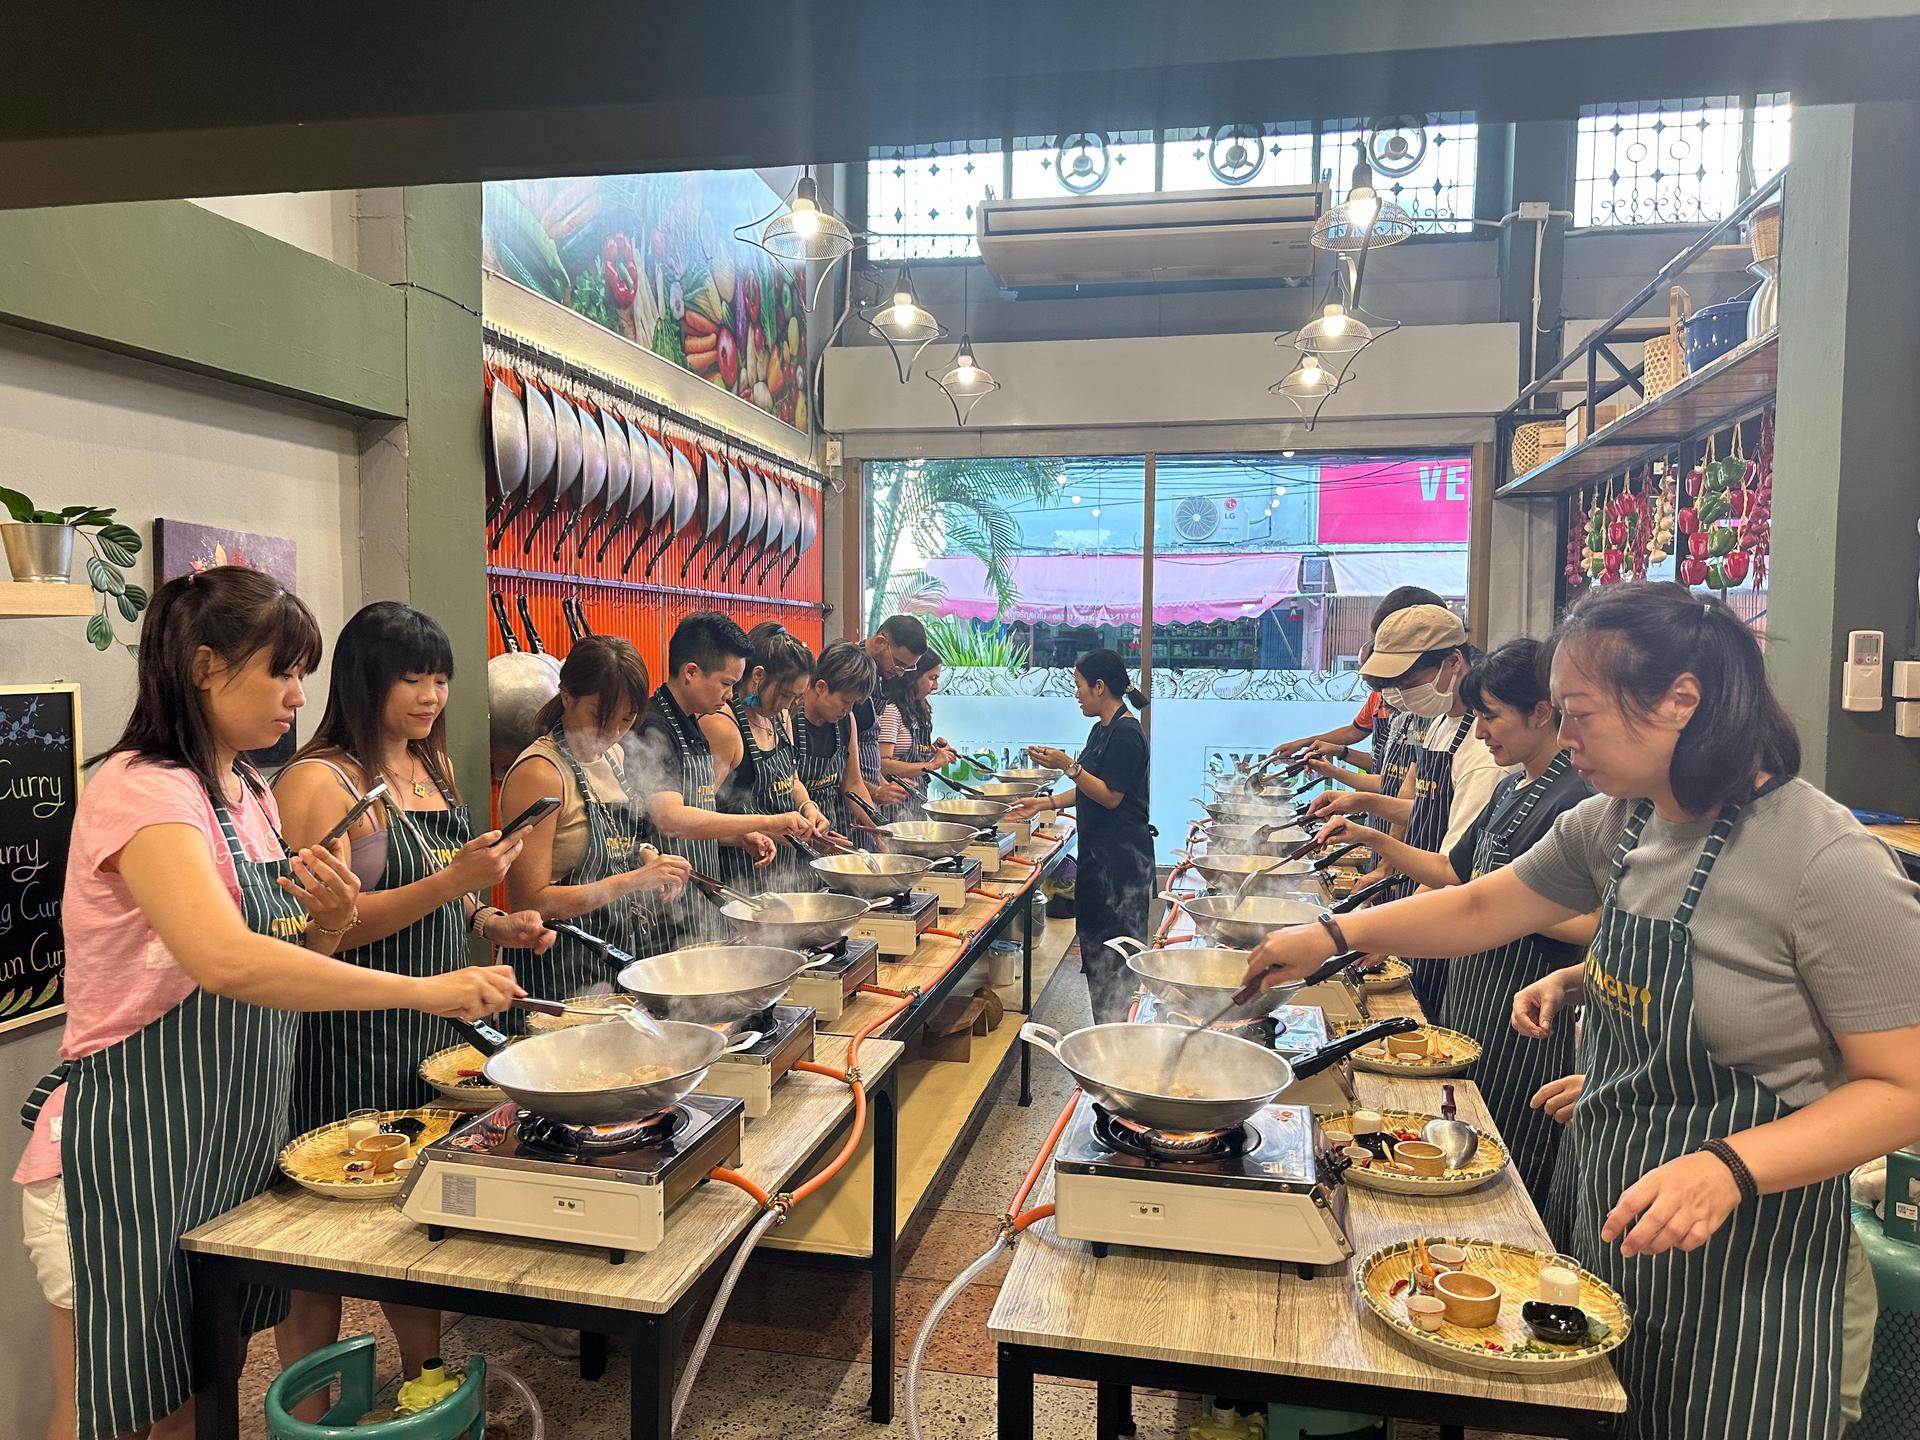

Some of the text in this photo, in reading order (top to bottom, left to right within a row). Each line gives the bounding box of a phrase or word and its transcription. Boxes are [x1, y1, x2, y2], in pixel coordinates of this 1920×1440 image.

[1419, 466, 1465, 500] VE
[20, 881, 63, 927] Cur
[31, 932, 65, 978] Cur
